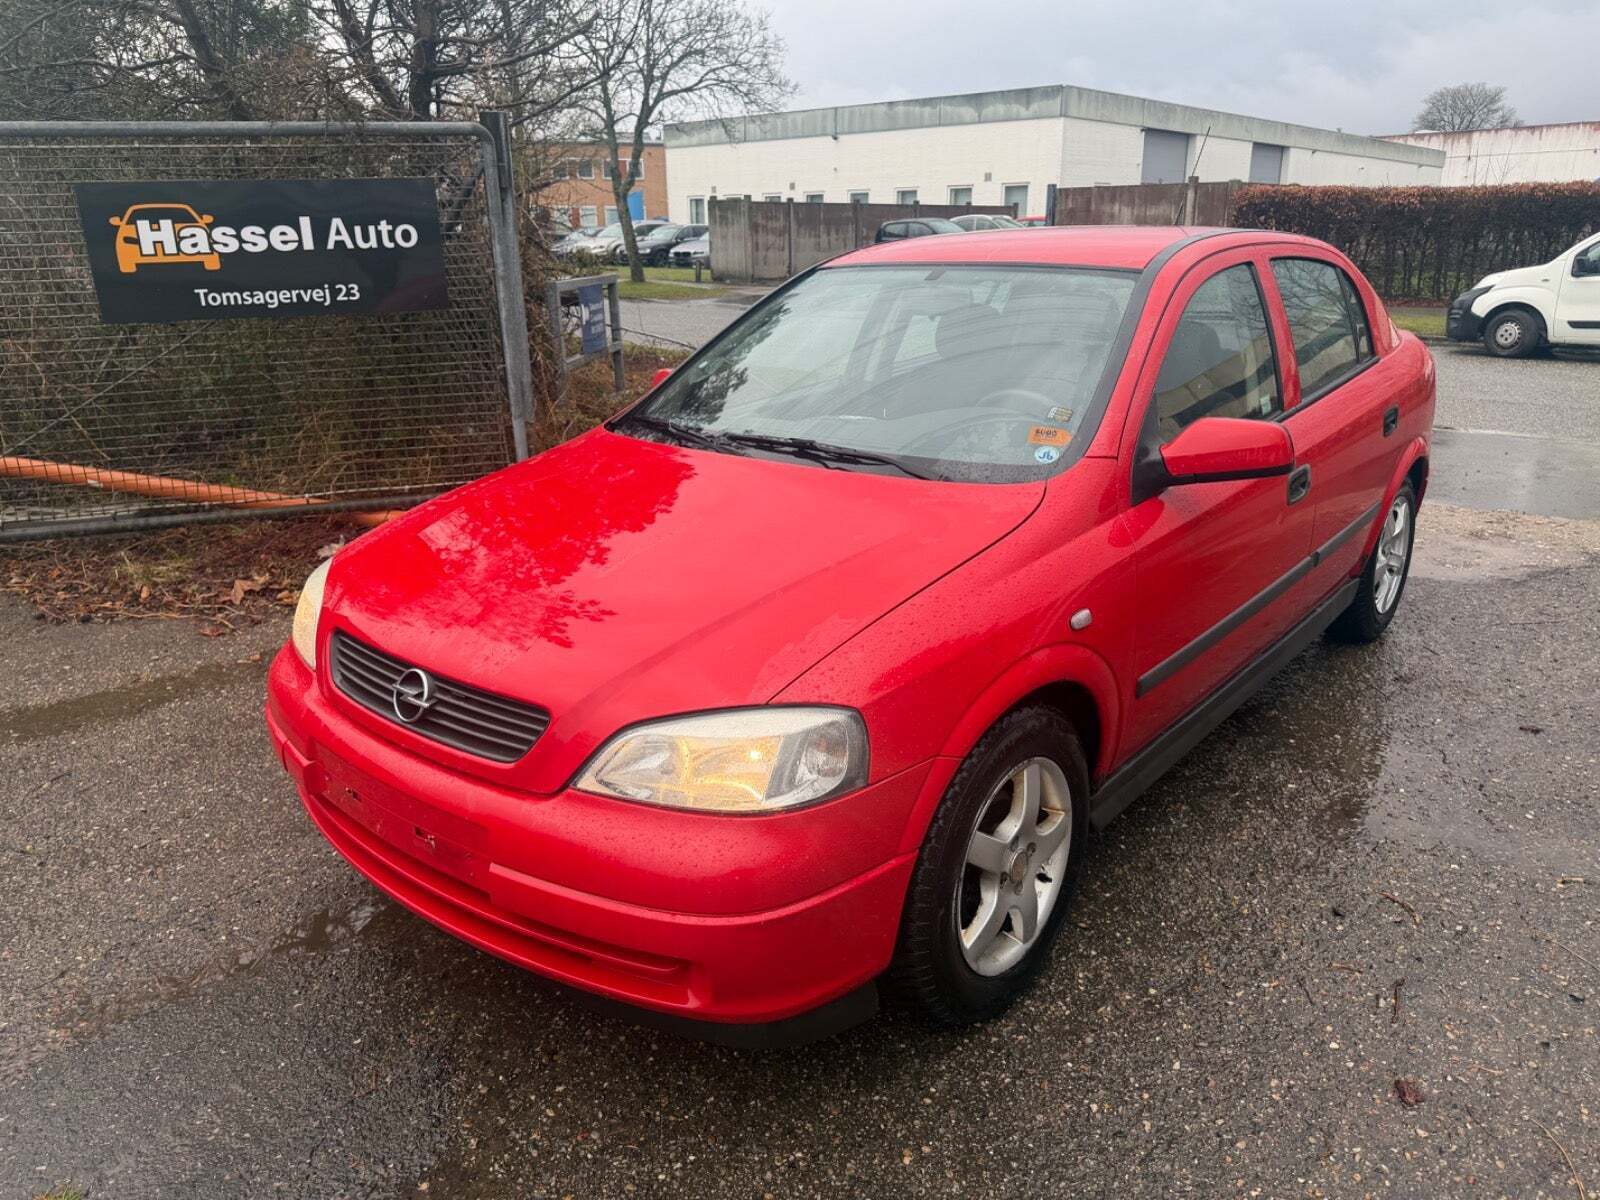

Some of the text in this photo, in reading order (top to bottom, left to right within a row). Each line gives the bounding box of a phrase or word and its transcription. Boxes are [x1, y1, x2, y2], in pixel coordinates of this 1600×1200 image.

[136, 216, 418, 255] Hassel Auto
[195, 284, 361, 309] Tomsagervej 23
